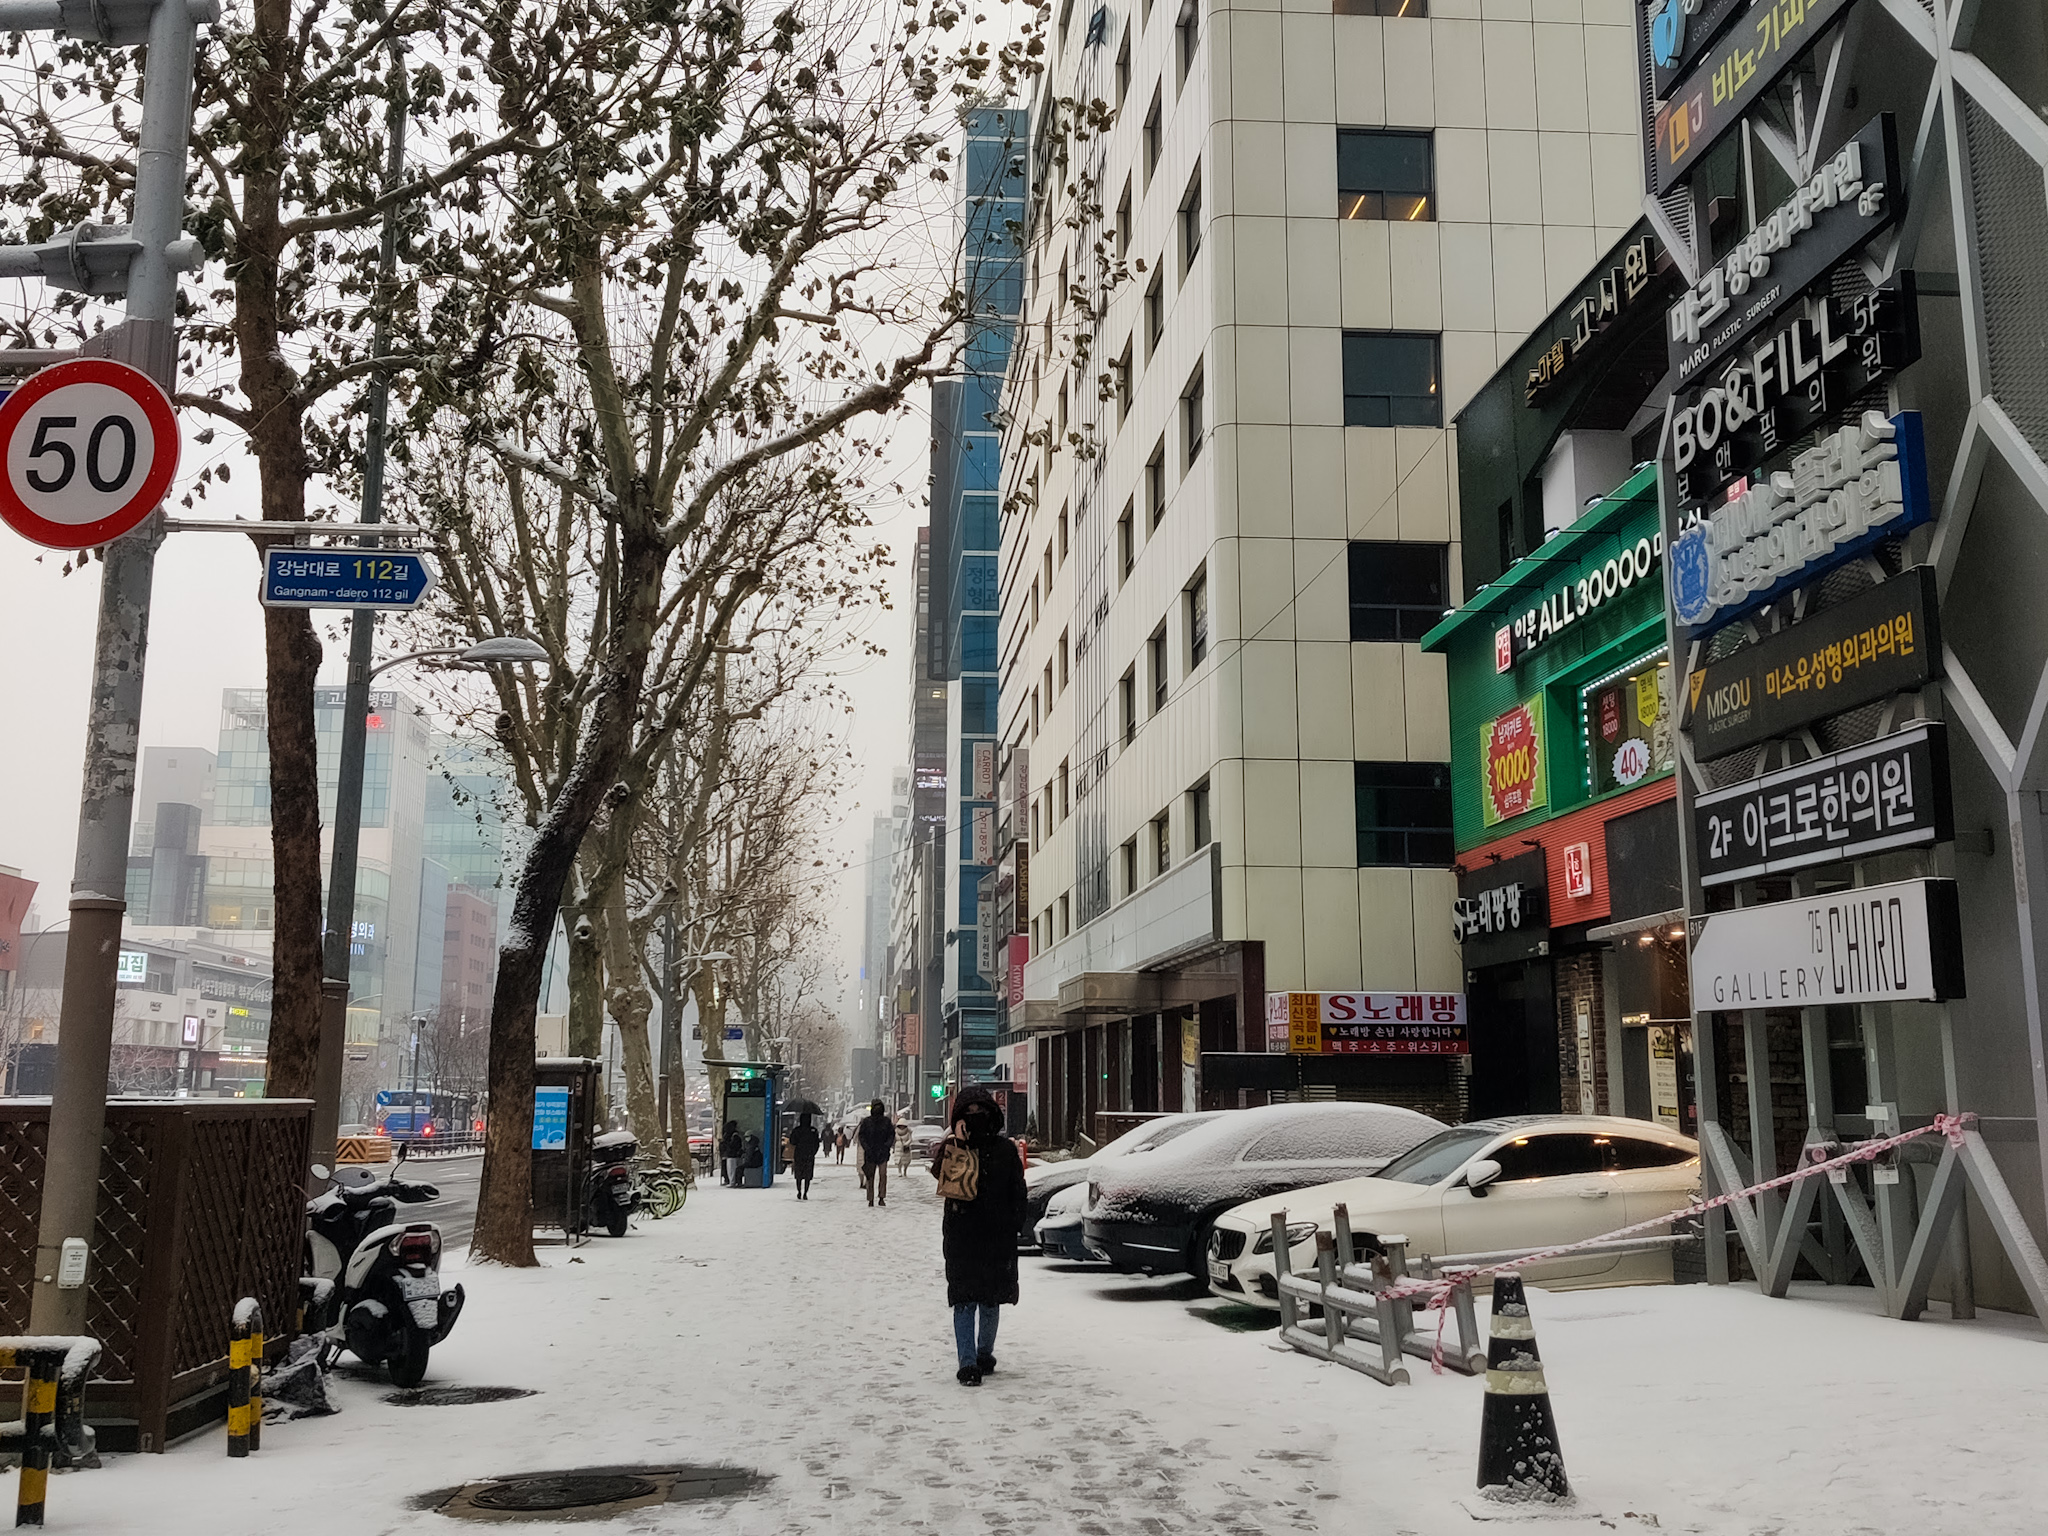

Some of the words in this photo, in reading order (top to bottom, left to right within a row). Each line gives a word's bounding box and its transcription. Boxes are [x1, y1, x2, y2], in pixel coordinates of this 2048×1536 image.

[1712, 0, 1818, 107] 비뇨기과
[1858, 183, 1884, 216] 6F
[1570, 236, 1649, 355] 고시원
[1679, 343, 1710, 379] MARQ
[1713, 318, 1743, 349] PLASTIC
[1746, 285, 1781, 320] SURGERY
[1672, 297, 1848, 473] BO&FILL
[1854, 290, 1880, 334] 5F
[26, 415, 136, 493] 50
[1714, 460, 1905, 605] 성형외과의원
[276, 560, 341, 578] 강남대로
[352, 559, 409, 581] 112길
[273, 585, 369, 599] Gangnam-daero
[372, 588, 392, 599] 112
[394, 588, 409, 600] gil
[1765, 611, 1915, 700] 미소유성형외과의원
[1692, 675, 1701, 691] 3F
[1706, 676, 1751, 721] MISOU
[1497, 715, 1523, 745] 남자커트
[982, 749, 991, 785] CARROT
[1494, 745, 1530, 792] 10000
[1621, 746, 1644, 779] 40%
[1708, 815, 1733, 860] 2F
[1743, 752, 1915, 857] 아크로한의원
[979, 811, 988, 855] 당근영어
[1690, 920, 1703, 936] B1F
[1828, 897, 1908, 995] CHIRO
[1713, 966, 1825, 1003] GALLERY
[1328, 995, 1459, 1023] S노래방
[1339, 1026, 1370, 1038] 노래방
[1374, 1026, 1395, 1038] 손님
[1400, 1025, 1452, 1039] 사랑합니다
[932, 1085, 943, 1097] 약
